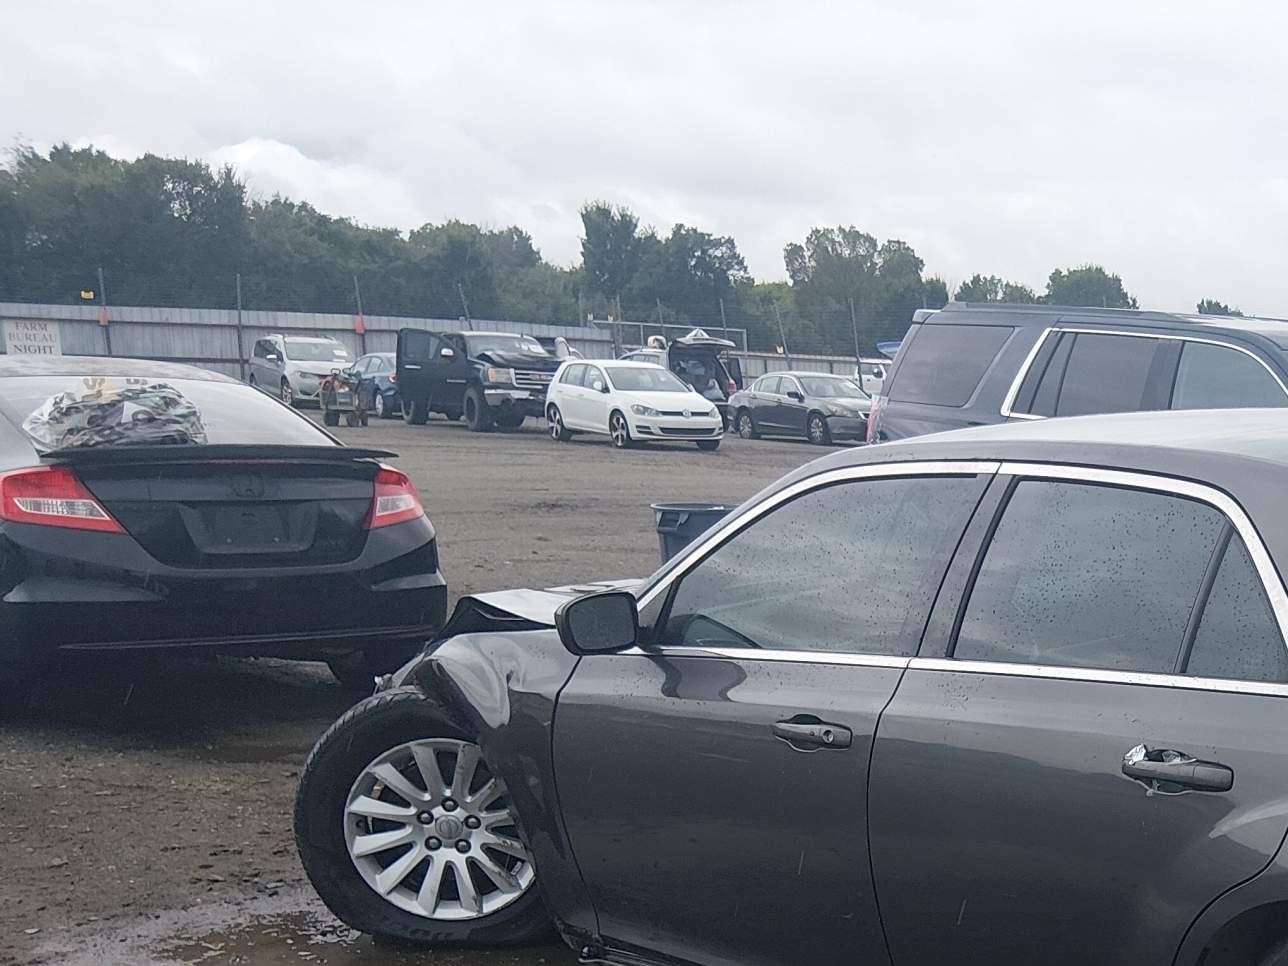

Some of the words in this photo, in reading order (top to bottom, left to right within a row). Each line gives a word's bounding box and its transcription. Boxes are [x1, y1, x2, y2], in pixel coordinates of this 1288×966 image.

[15, 321, 48, 332] FARM
[8, 332, 57, 343] BUREAU
[13, 344, 55, 354] NIGHT
